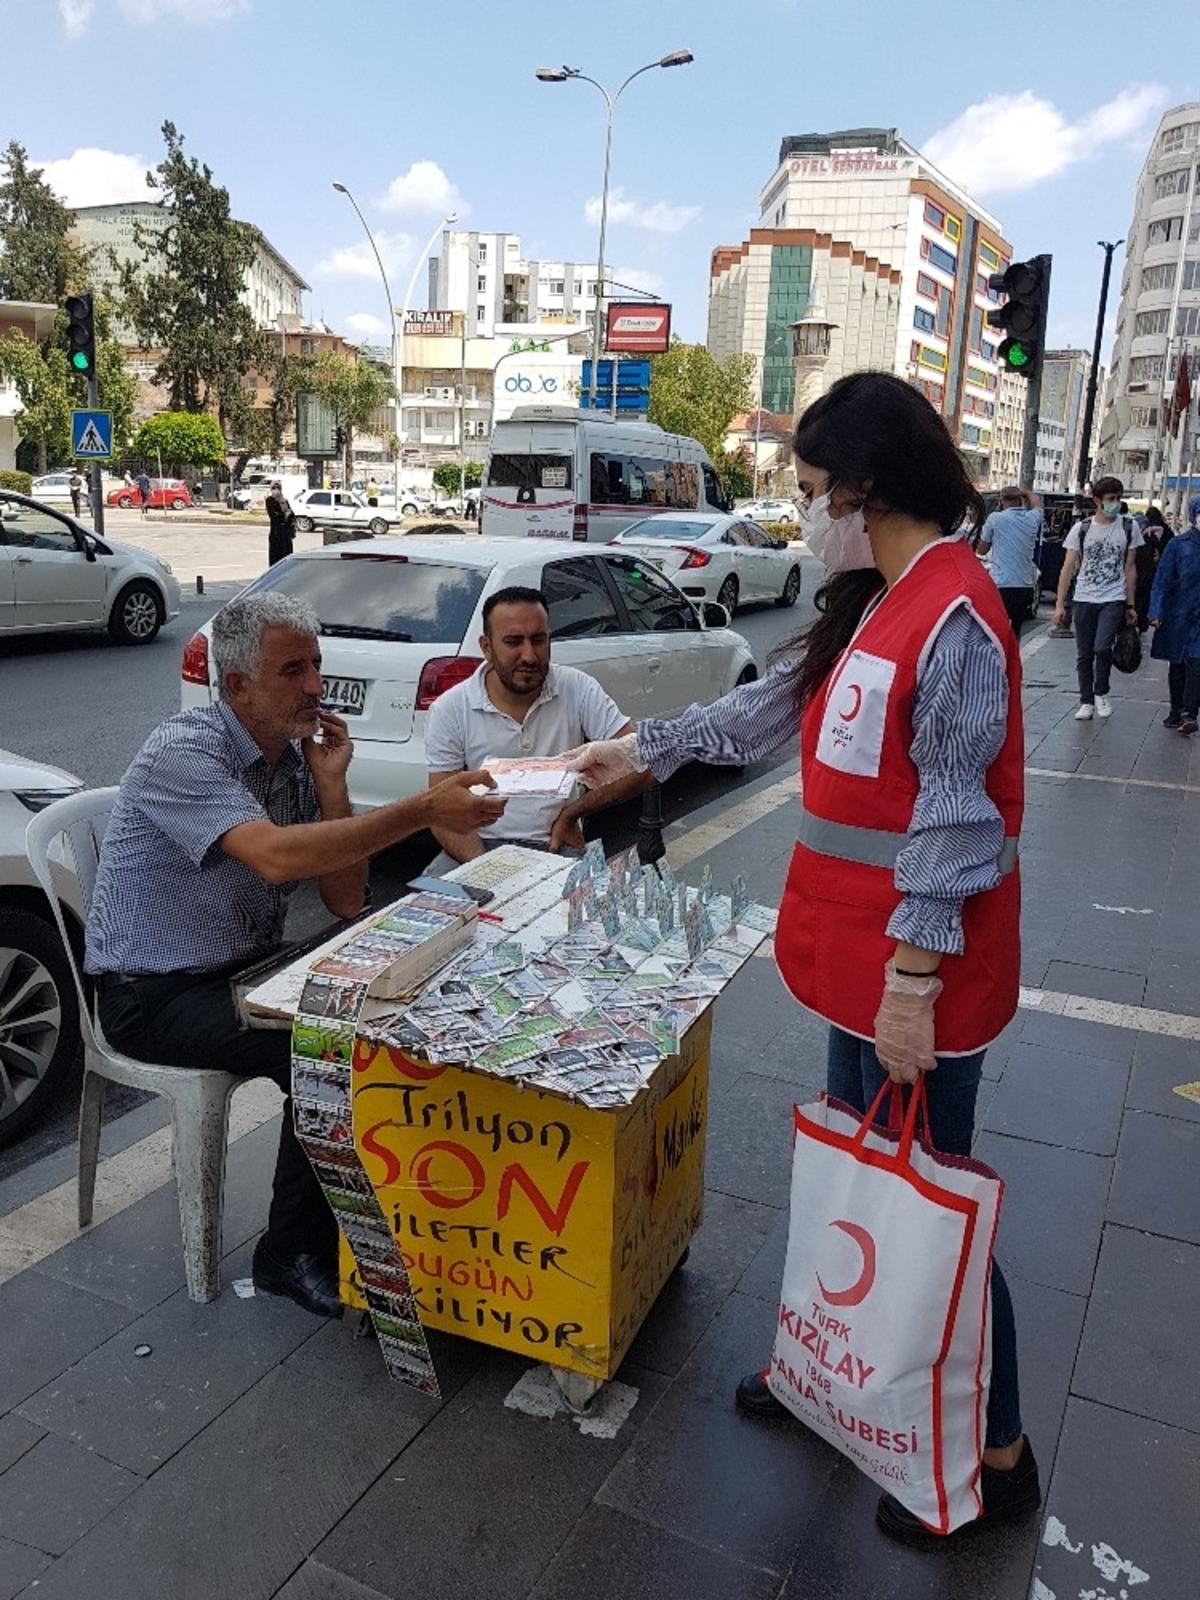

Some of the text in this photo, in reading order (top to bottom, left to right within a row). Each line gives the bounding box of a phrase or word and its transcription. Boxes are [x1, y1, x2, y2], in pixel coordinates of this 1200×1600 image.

[790, 159, 828, 173] OTEL
[360, 1118, 590, 1238] SON
[392, 1202, 596, 1289] İLETLER
[780, 1303, 876, 1390] KIZILAY
[805, 1359, 832, 1394] 1868
